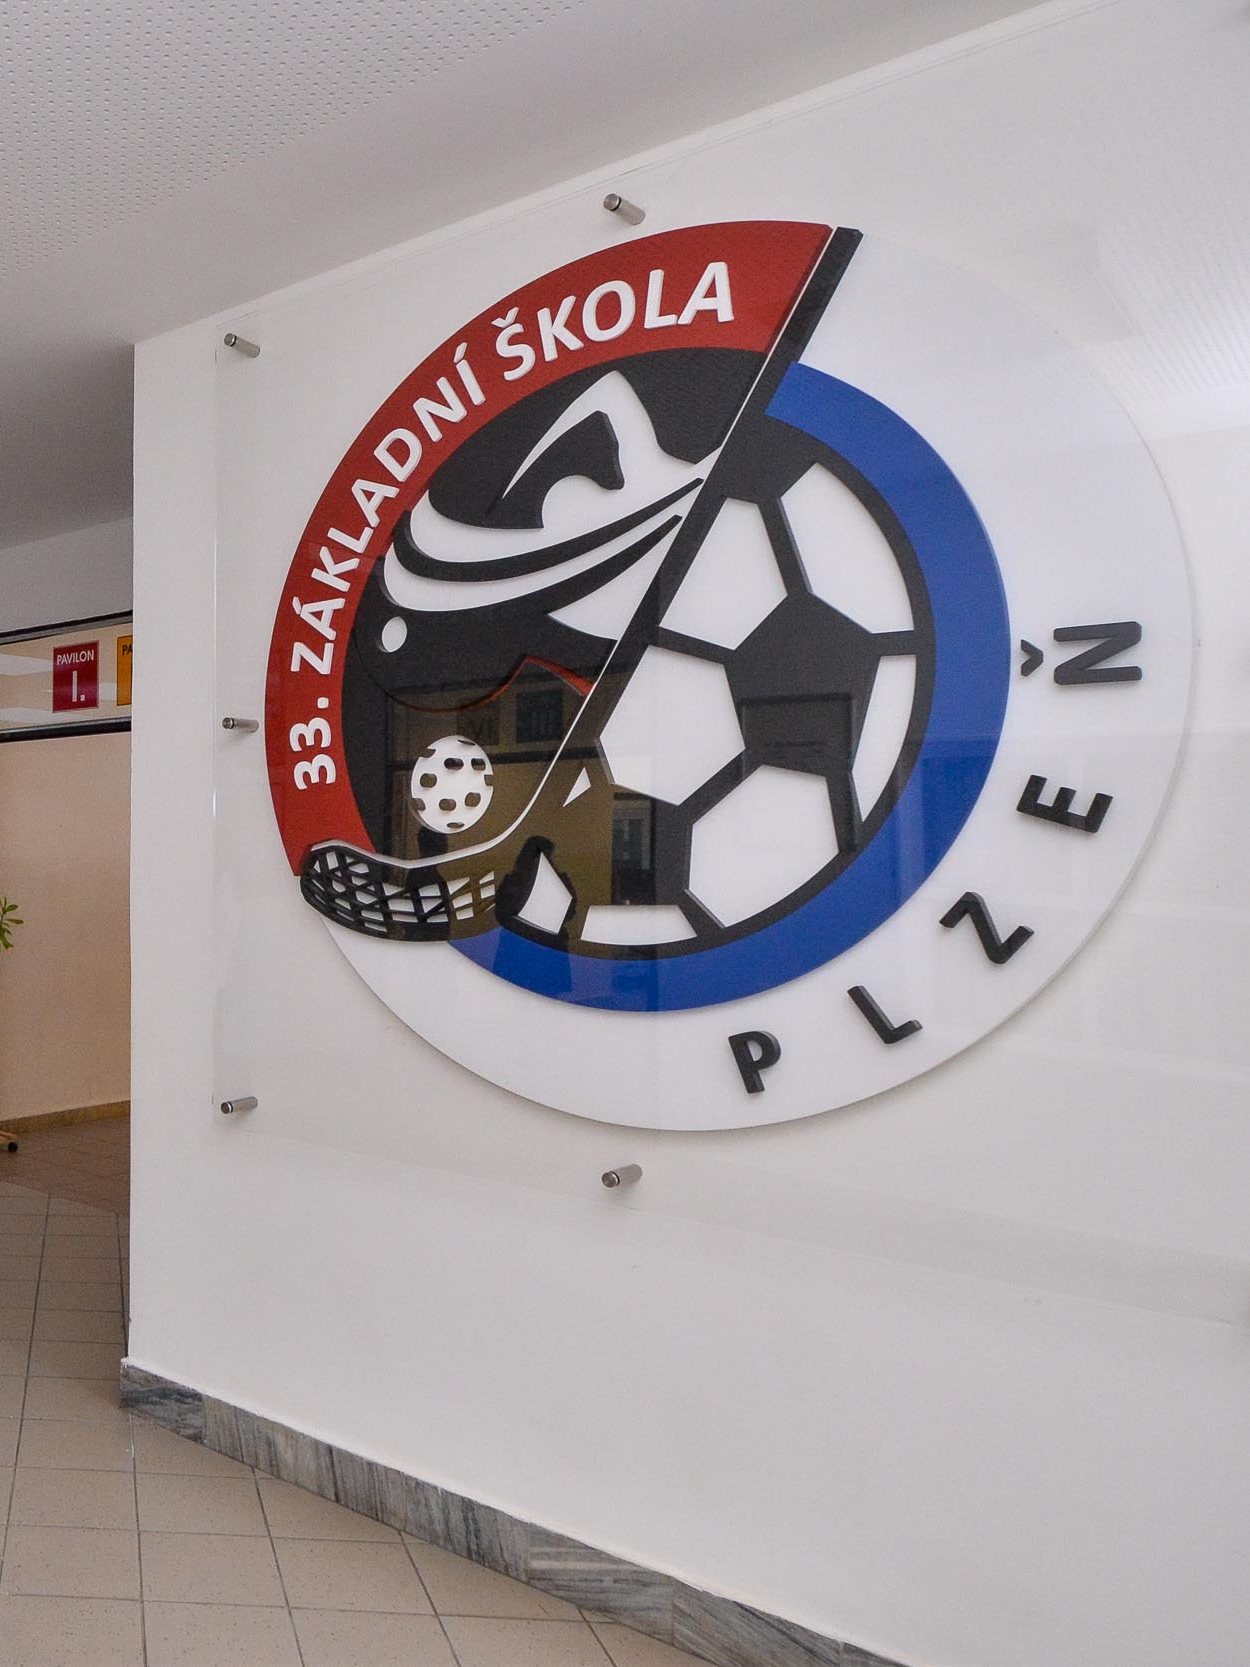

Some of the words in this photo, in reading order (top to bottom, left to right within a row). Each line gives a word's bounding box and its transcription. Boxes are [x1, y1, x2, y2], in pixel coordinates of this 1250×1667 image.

[491, 261, 735, 381] ŠKOLA
[290, 341, 487, 676] ZÁKLADNÍ
[56, 649, 95, 666] PAVILON
[289, 696, 337, 791] 33.
[727, 620, 1143, 1095] PLZEŇ
